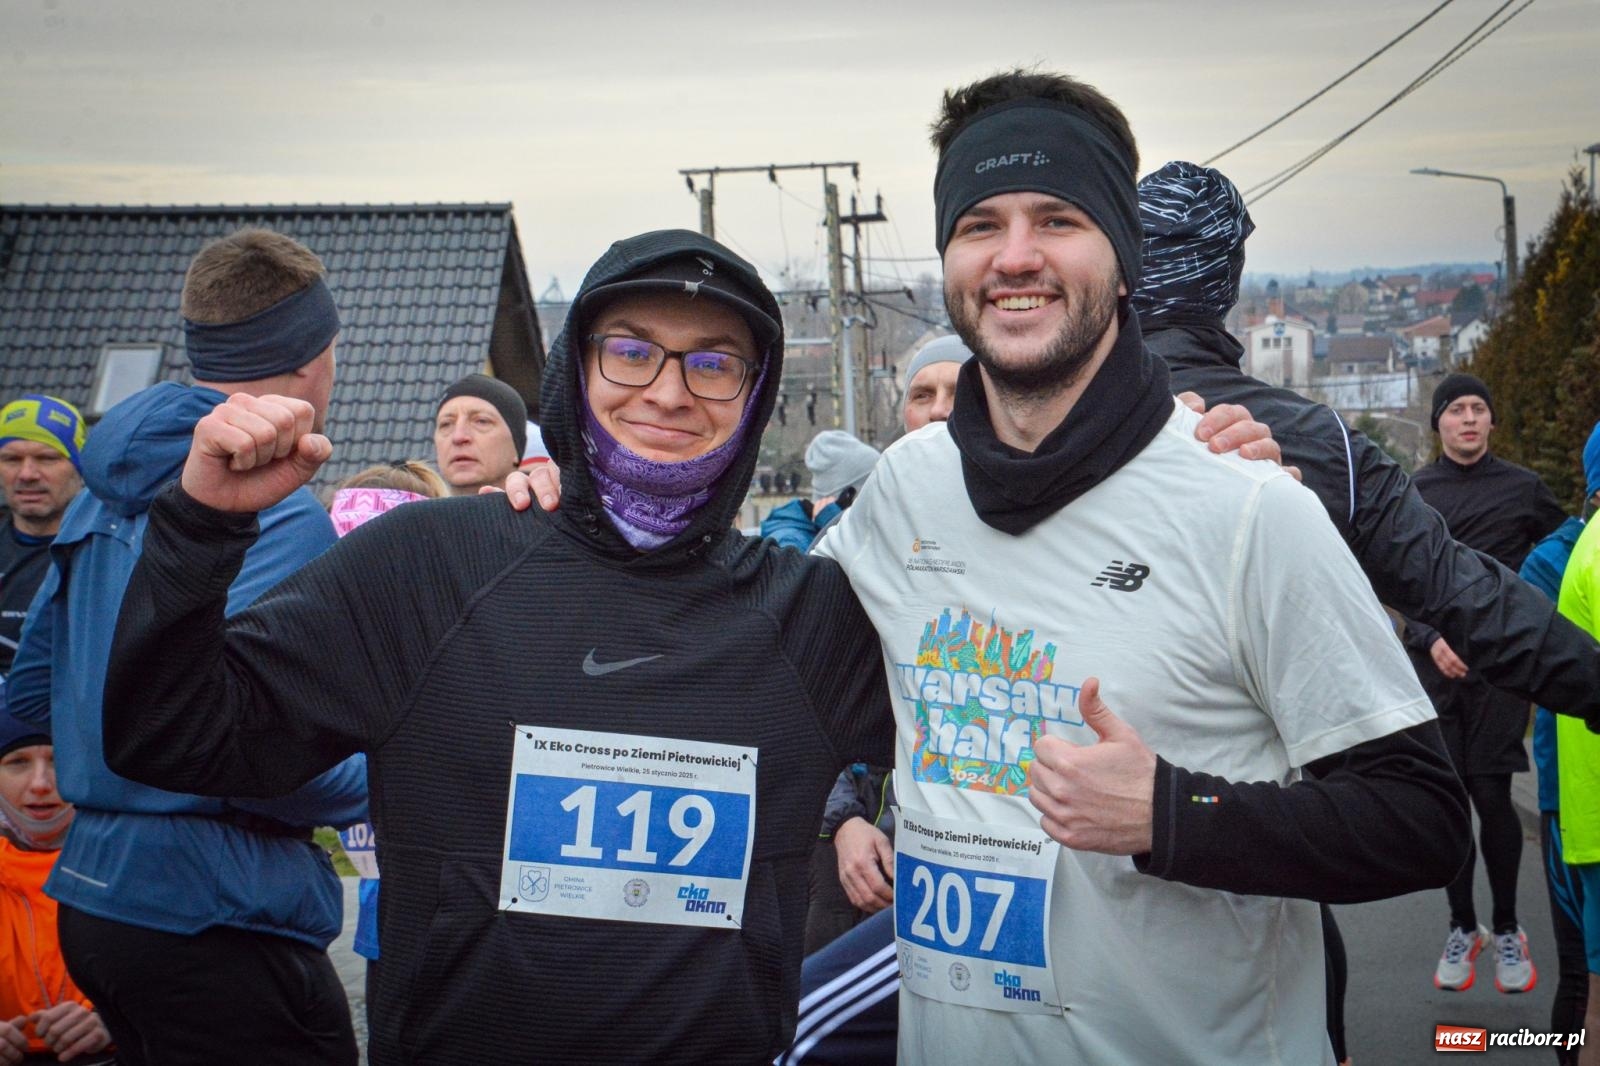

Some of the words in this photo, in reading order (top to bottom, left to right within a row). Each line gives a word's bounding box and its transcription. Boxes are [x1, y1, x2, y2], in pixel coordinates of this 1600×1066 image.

[975, 153, 1032, 173] CRAFT
[896, 663, 1085, 726] warsaw
[534, 740, 548, 750] IX
[549, 741, 572, 752] Eko
[574, 743, 611, 756] Cross
[612, 748, 629, 760] po
[630, 748, 667, 761] Ziemi
[667, 751, 741, 771] Pietrowickiej
[927, 706, 1032, 766] half
[581, 762, 615, 772] Pietrowice
[678, 771, 694, 779] 2025
[560, 785, 716, 867] 119
[909, 821, 918, 832] Eko
[918, 824, 934, 838] Cross
[934, 830, 944, 841] po
[944, 830, 971, 844] Ziemi
[972, 834, 1042, 855] Pietrowickiej
[911, 865, 1015, 951] 207
